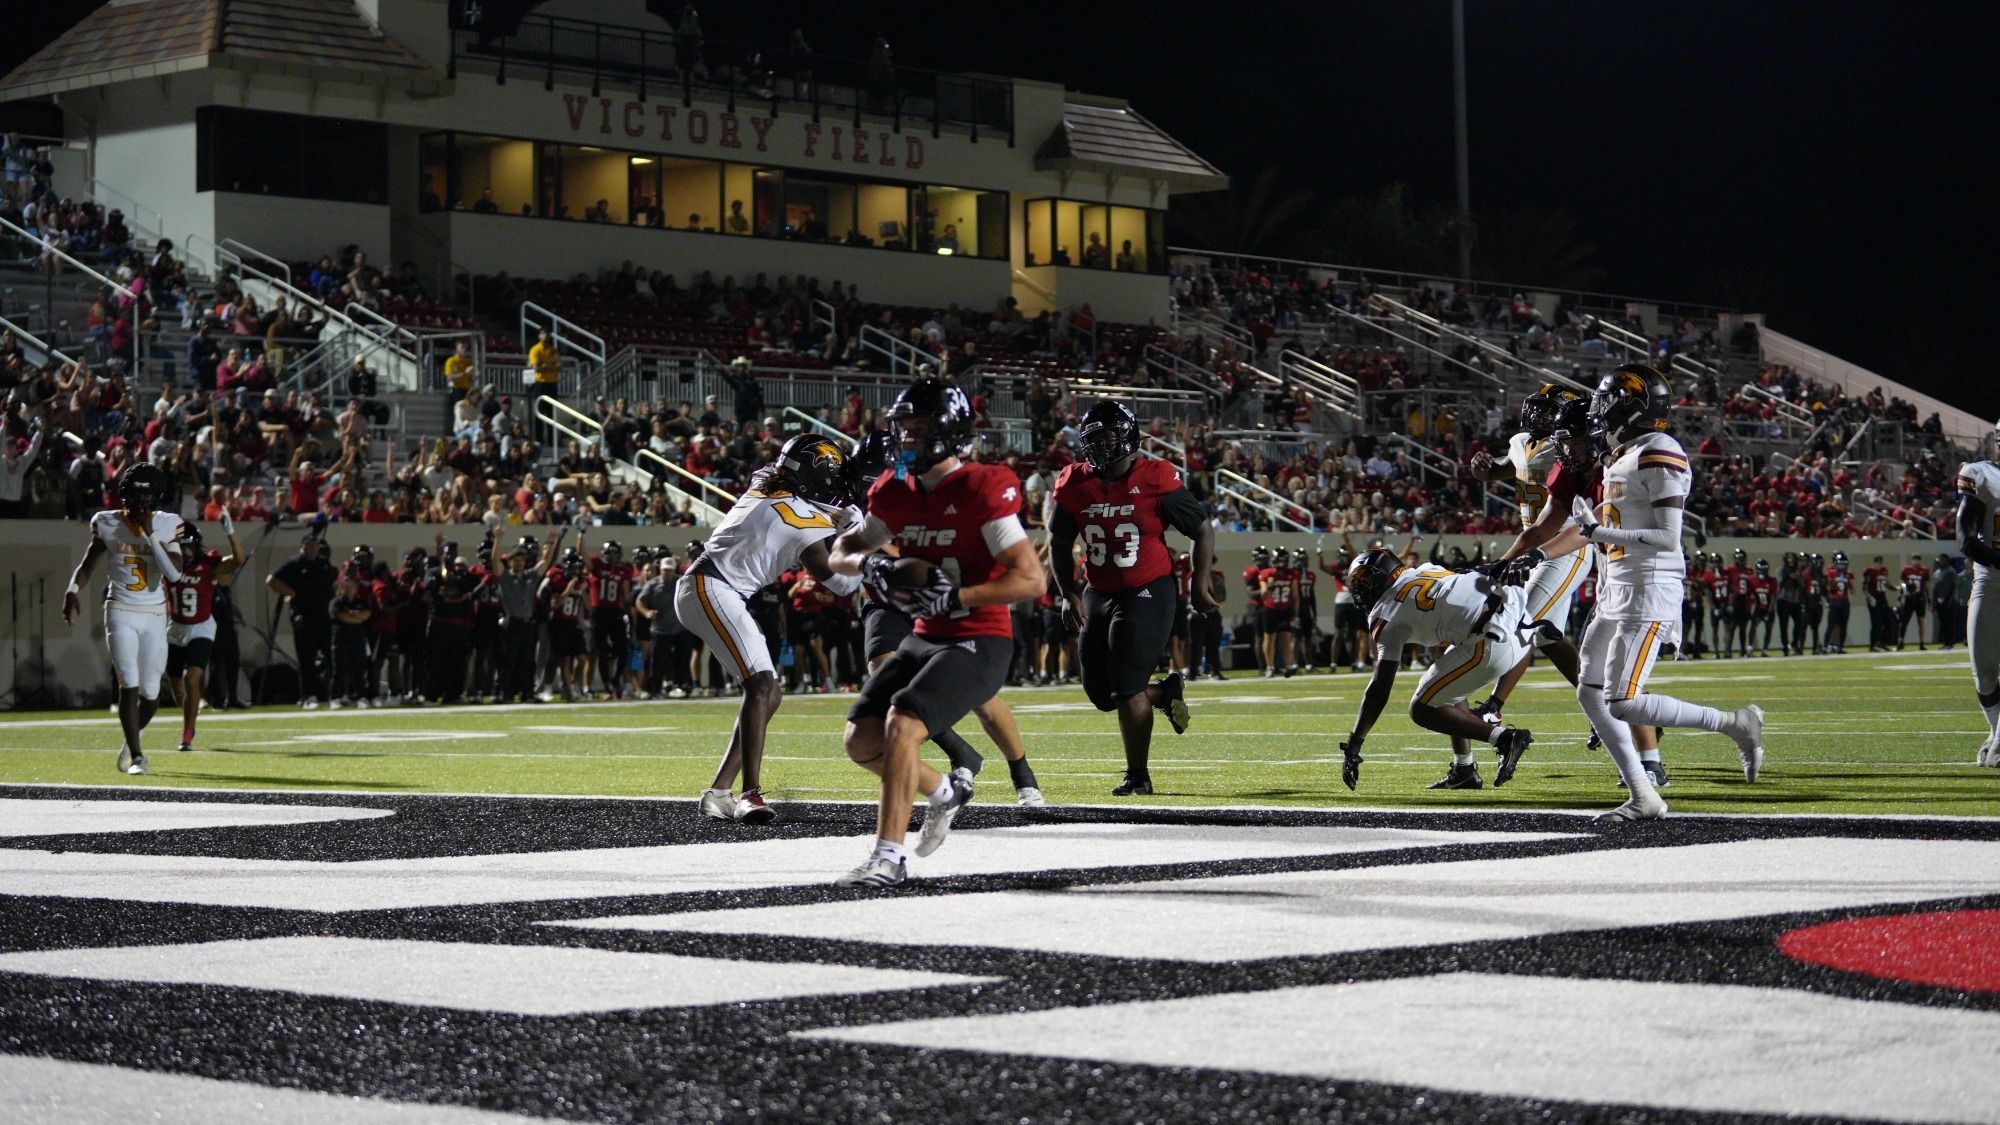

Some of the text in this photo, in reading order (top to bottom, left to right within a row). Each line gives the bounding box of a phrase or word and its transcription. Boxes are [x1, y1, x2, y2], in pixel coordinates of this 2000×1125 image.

[563, 93, 924, 169] VICTORY FIELD
[946, 387, 970, 413] 34
[1080, 503, 1135, 518] Fire
[896, 525, 957, 547] Fire
[1084, 522, 1140, 568] 63
[124, 556, 148, 592] 3
[169, 587, 198, 618] 19
[600, 578, 618, 602] 18
[1272, 586, 1291, 603] 42
[563, 597, 582, 616] 81
